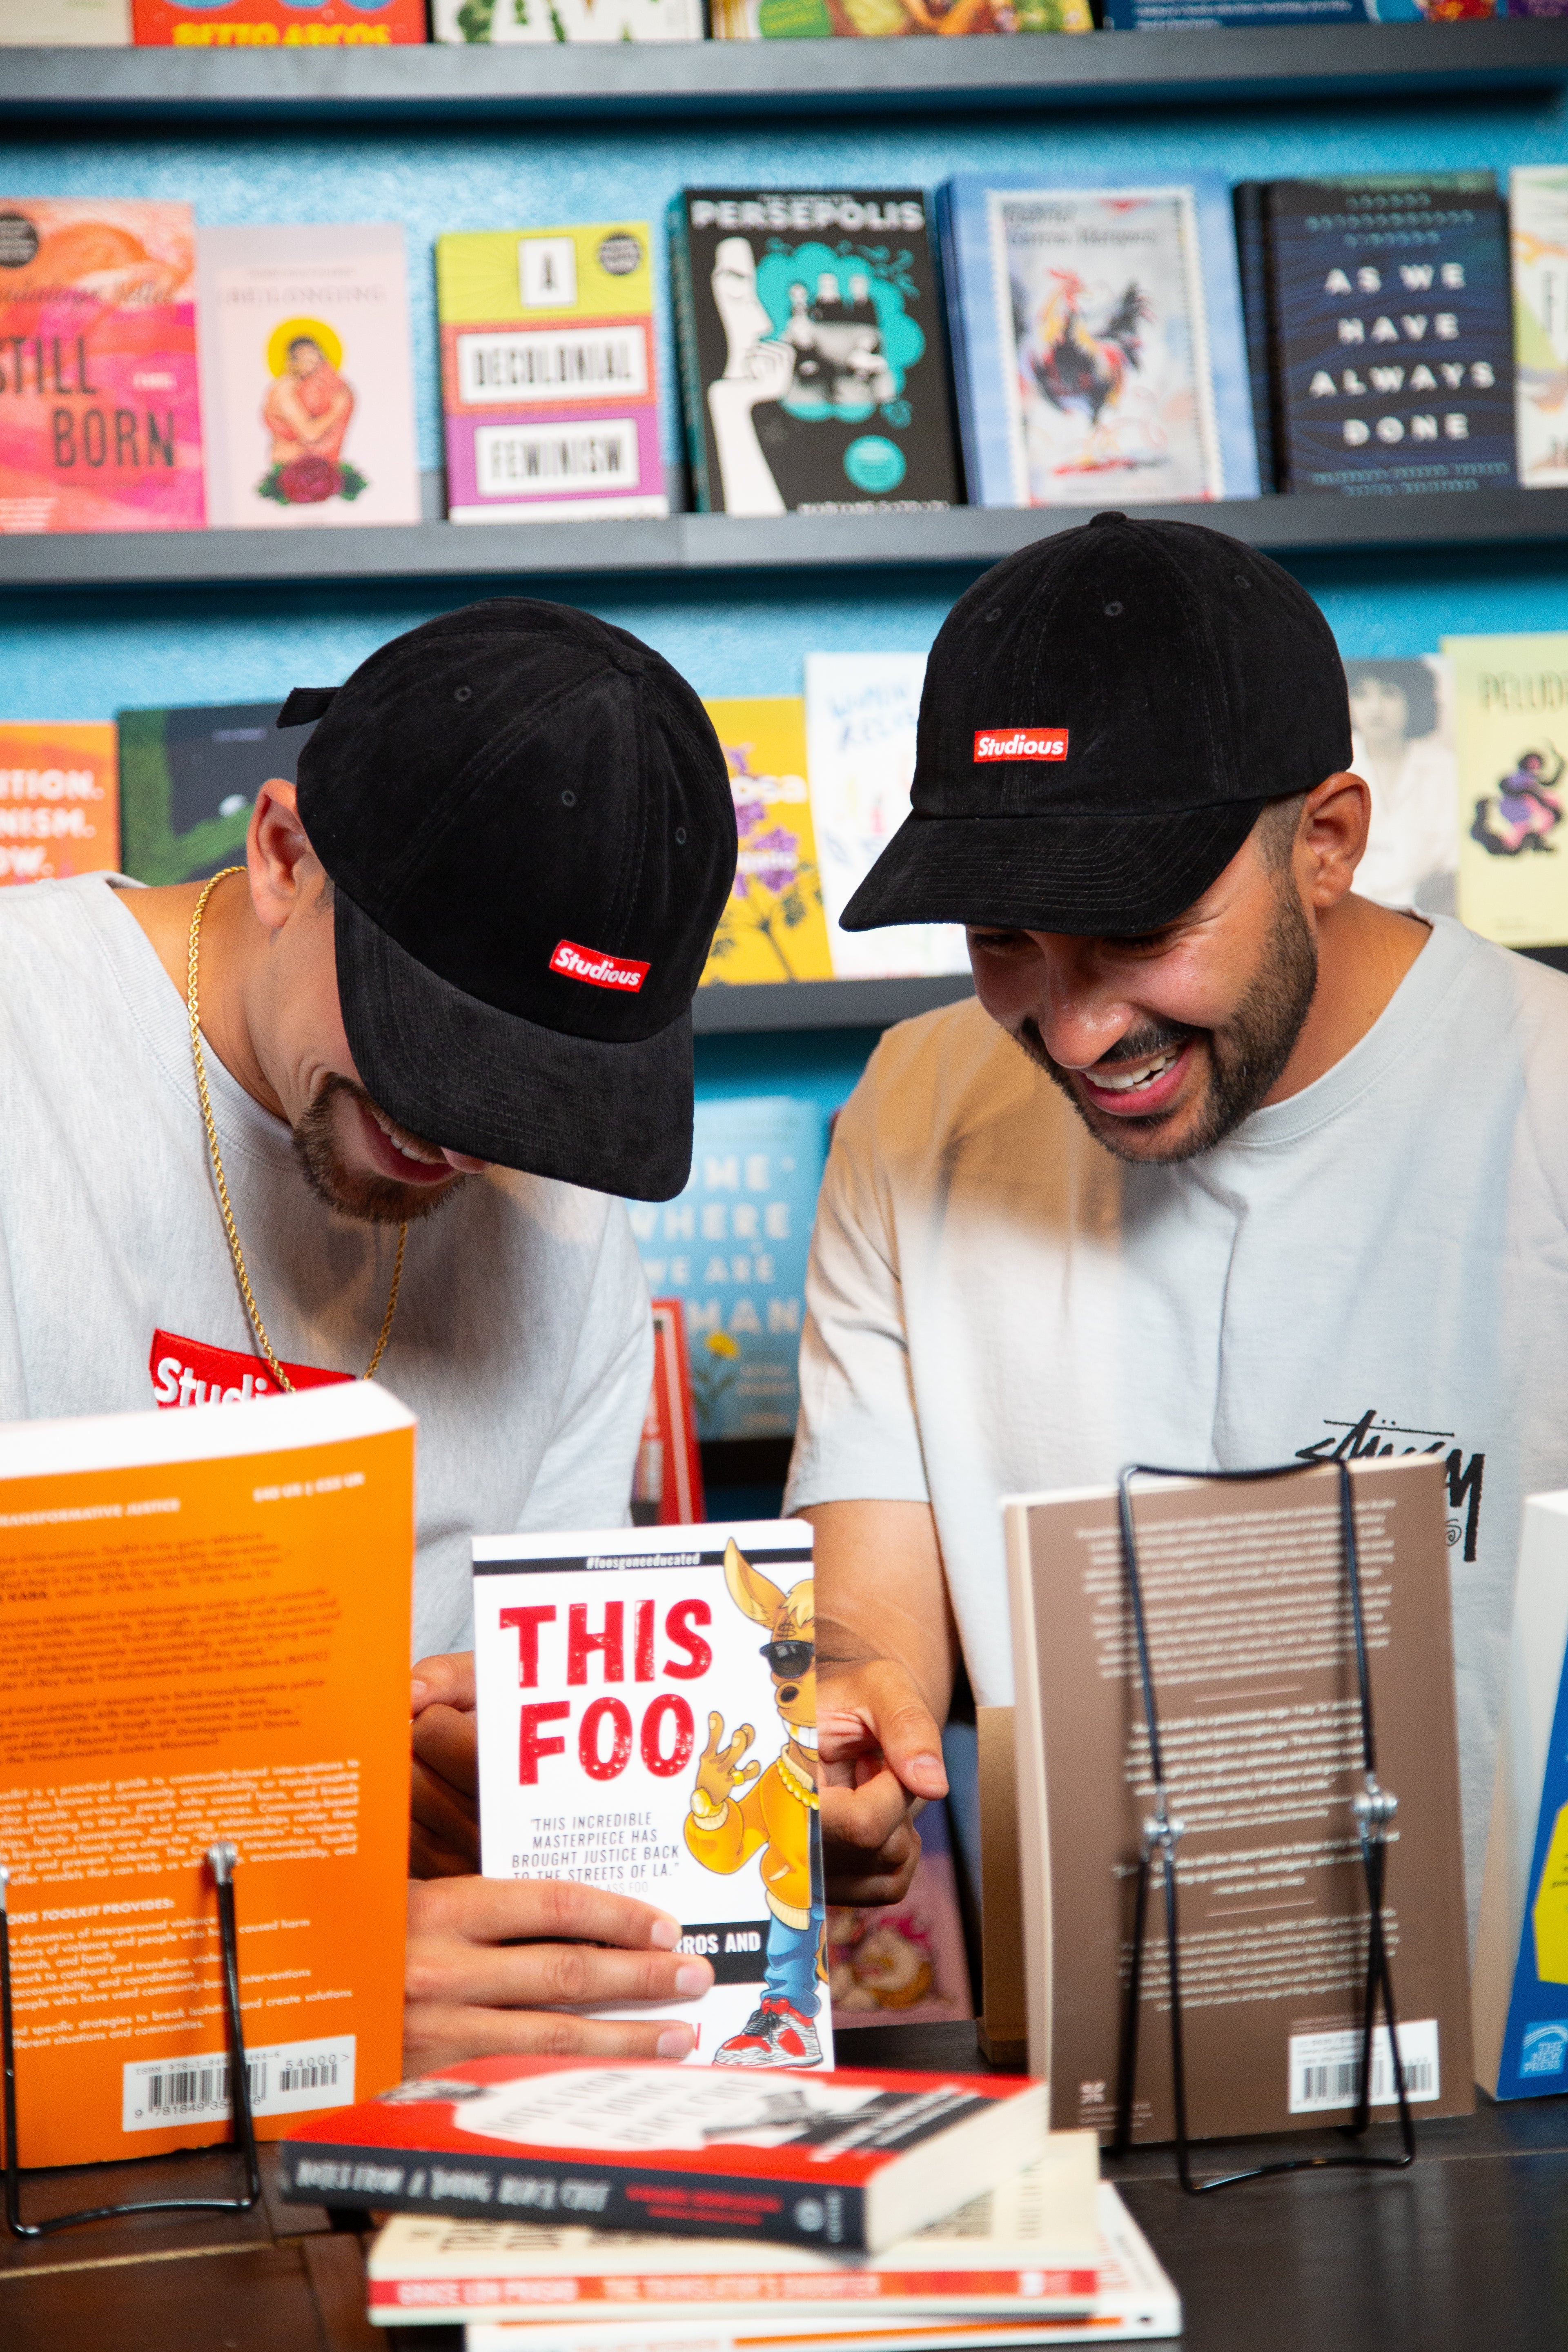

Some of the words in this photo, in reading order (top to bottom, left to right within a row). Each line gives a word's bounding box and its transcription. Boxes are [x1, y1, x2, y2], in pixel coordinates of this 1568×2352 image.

[691, 200, 925, 232] PERSEPOLIS
[539, 254, 558, 292] A
[1324, 265, 1383, 296] AS
[1399, 262, 1466, 292] WE
[1338, 313, 1459, 345] HAVE
[474, 342, 632, 386] DECOLONIAL
[1308, 361, 1495, 399] ALWAYS
[52, 408, 176, 468] BORN
[1342, 412, 1469, 447] DONE
[490, 434, 623, 480] FEMINISM
[978, 734, 1064, 756] Studious
[555, 948, 641, 985] Studious
[683, 1153, 771, 1192] ME
[630, 1201, 791, 1241] WHERE
[704, 1253, 775, 1285] ARE
[125, 1496, 181, 1517] JUSTICE
[586, 1552, 701, 1570] #foosgoneeducated
[499, 1599, 712, 1688] THIS
[519, 1693, 695, 1786] FOO
[1256, 1786, 1271, 1796] of
[1269, 1784, 1301, 1795] Audre
[531, 1817, 565, 1832] "THIS
[572, 1812, 651, 1829] INCREDIBLE
[12, 1848, 51, 1859] friends
[54, 1845, 78, 1856] and
[79, 1842, 114, 1853] family
[118, 1842, 137, 1850] are
[140, 1838, 169, 1847] often
[172, 1835, 189, 1844] the
[532, 1831, 624, 1850] MASTERPIECE
[632, 1829, 657, 1844] HAS
[512, 1851, 577, 1869] BROUGHT
[584, 1848, 637, 1864] JUSTICE
[644, 1845, 679, 1860] BACK
[1194, 1855, 1215, 1866] will
[1214, 1854, 1230, 1864] be
[1229, 1848, 1282, 1861] important
[1281, 1845, 1294, 1855] to
[1293, 1843, 1325, 1853] those
[568, 1866, 624, 1882] STREETS
[631, 1865, 646, 1878] OF
[1195, 1872, 1211, 1882] up
[1313, 1857, 1334, 1867] and
[629, 1881, 648, 1894] FOO
[42, 1905, 101, 1920] TOOLKIT
[102, 1899, 174, 1913] PROVIDES:
[20, 1932, 74, 1946] dynamics
[77, 1927, 90, 1942] of
[92, 1921, 167, 1936] interpersonal
[170, 1917, 217, 1927] violence
[46, 1943, 59, 1954] of
[62, 1942, 109, 1956] violence
[112, 1936, 136, 1947] and
[138, 1933, 177, 1947] people
[180, 1930, 204, 1939] who
[238, 1921, 278, 1933] caused
[281, 1920, 310, 1928] harm
[725, 1932, 762, 1954] AND
[45, 1973, 57, 1981] to
[60, 1967, 108, 1979] confront
[110, 1962, 134, 1974] and
[135, 1958, 189, 1970] transform
[56, 1955, 79, 1967] and
[81, 1951, 116, 1968] family
[53, 1996, 77, 2005] who
[80, 1990, 109, 2002] have
[112, 1987, 139, 1999] used
[241, 1970, 311, 1983] interventions
[98, 1976, 121, 1988] and
[123, 1971, 194, 1985] coordination
[32, 2021, 73, 2036] specific
[78, 2017, 132, 2029] strategies
[152, 2009, 184, 2020] break
[238, 1998, 262, 2010] and
[266, 1996, 301, 2006] create
[305, 1991, 352, 2001] solutions
[54, 2033, 106, 2045] situations
[109, 2027, 132, 2038] and
[134, 2021, 204, 2035] communities.
[135, 2066, 161, 2075] ISBN
[285, 2054, 337, 2070] 54000
[1523, 2060, 1561, 2073] PRESS
[134, 2109, 143, 2119] 9
[154, 2102, 205, 2117] 781849
